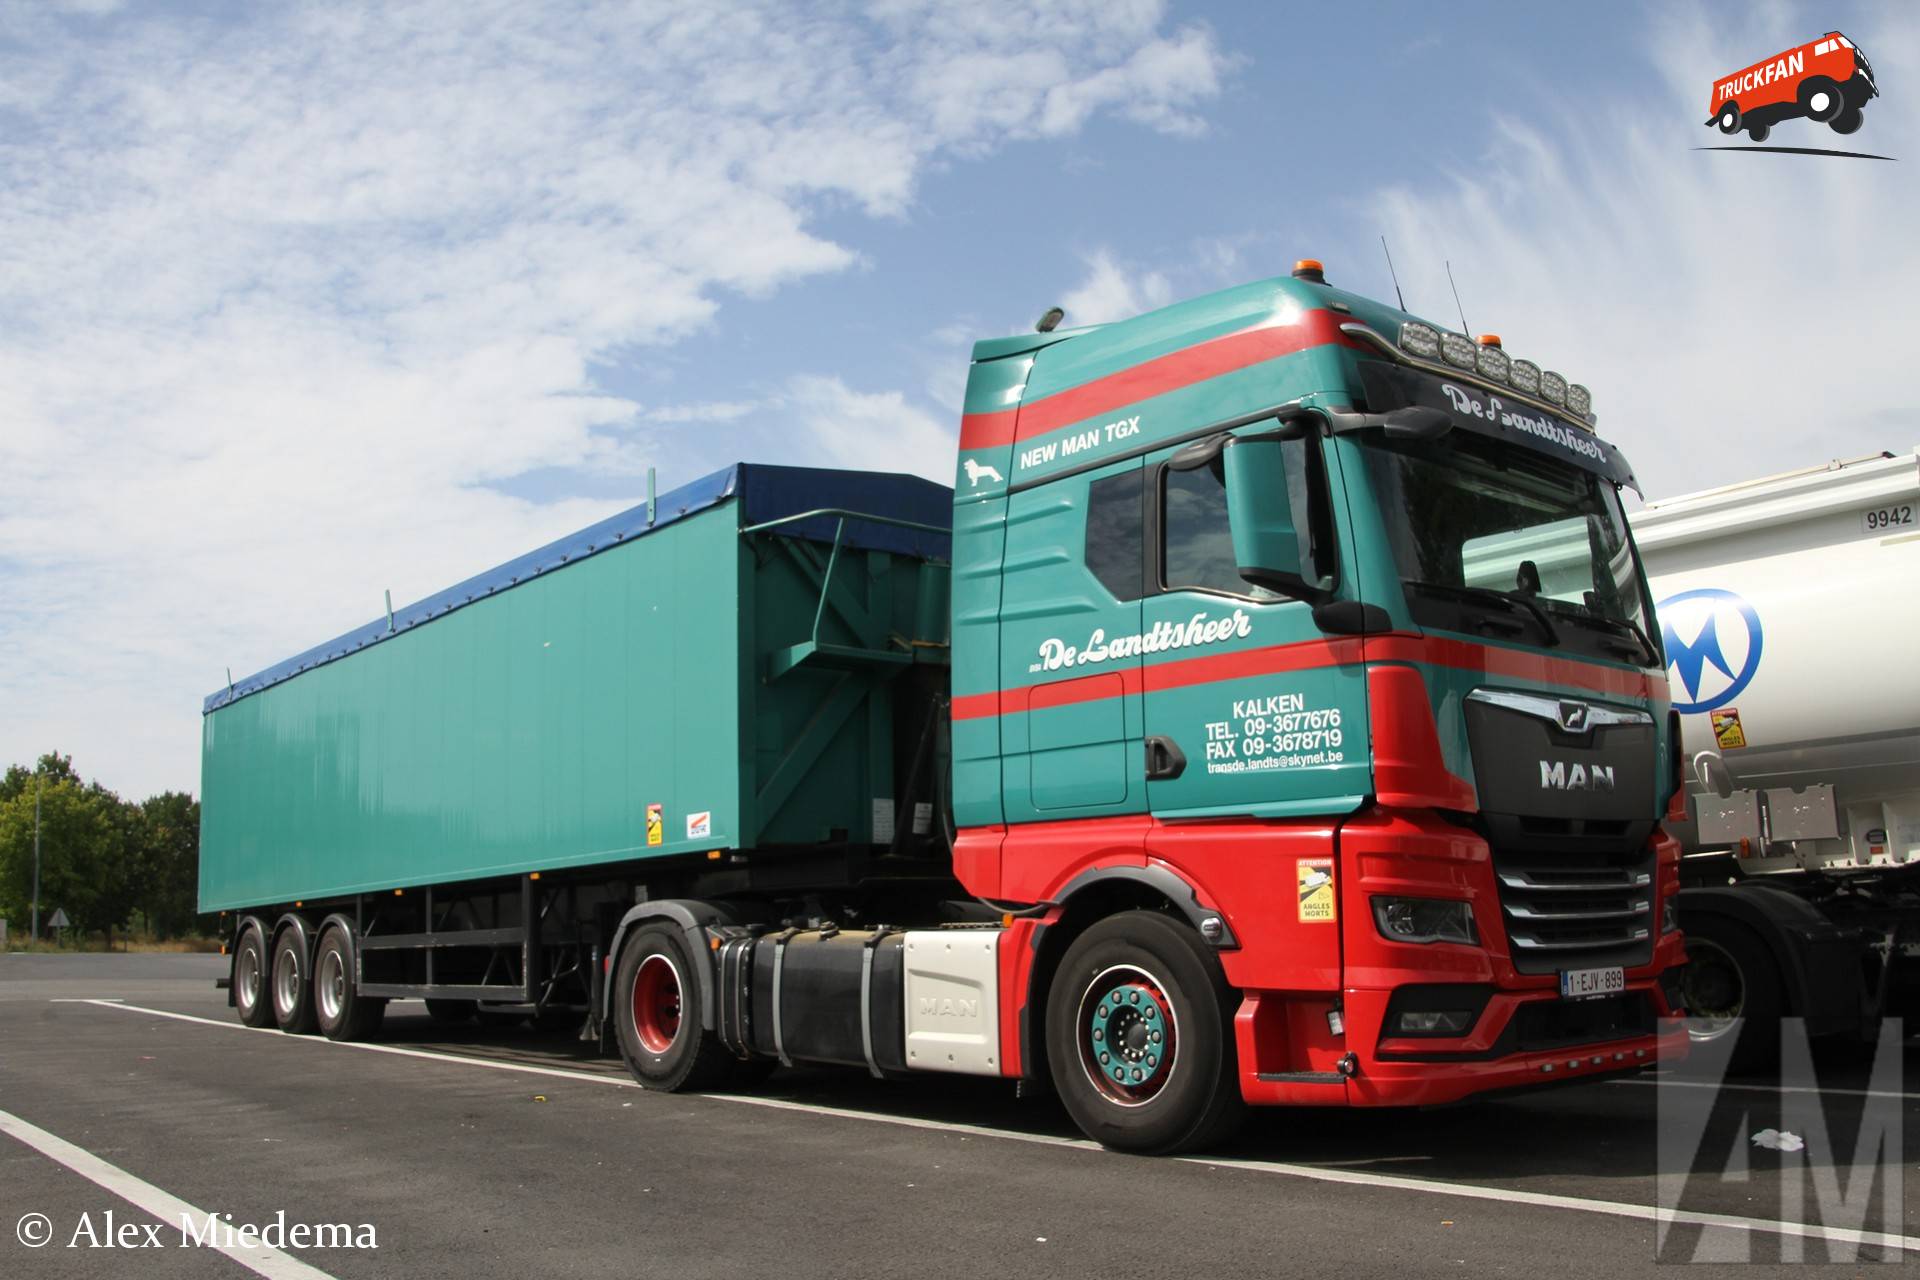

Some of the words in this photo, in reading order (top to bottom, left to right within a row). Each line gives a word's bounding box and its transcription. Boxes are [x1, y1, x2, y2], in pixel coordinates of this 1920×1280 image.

[1442, 383, 1483, 418] De
[1020, 442, 1058, 470] NEW
[1061, 428, 1100, 457] MAN
[1104, 415, 1141, 443] TGX
[1867, 505, 1912, 530] 9942
[1039, 638, 1076, 671] De
[1077, 608, 1252, 665] Landtsheer
[1232, 693, 1304, 719] KALKEN
[1205, 721, 1239, 741] TEL.
[1244, 708, 1342, 737] 09-3677676
[1206, 740, 1236, 760] FAX
[1242, 728, 1343, 756] 09-3678719
[1207, 750, 1344, 774] transde.landts@skynet.be
[1539, 760, 1615, 792] MAN
[1303, 902, 1331, 910] ANGLES
[919, 997, 977, 1018] MAN
